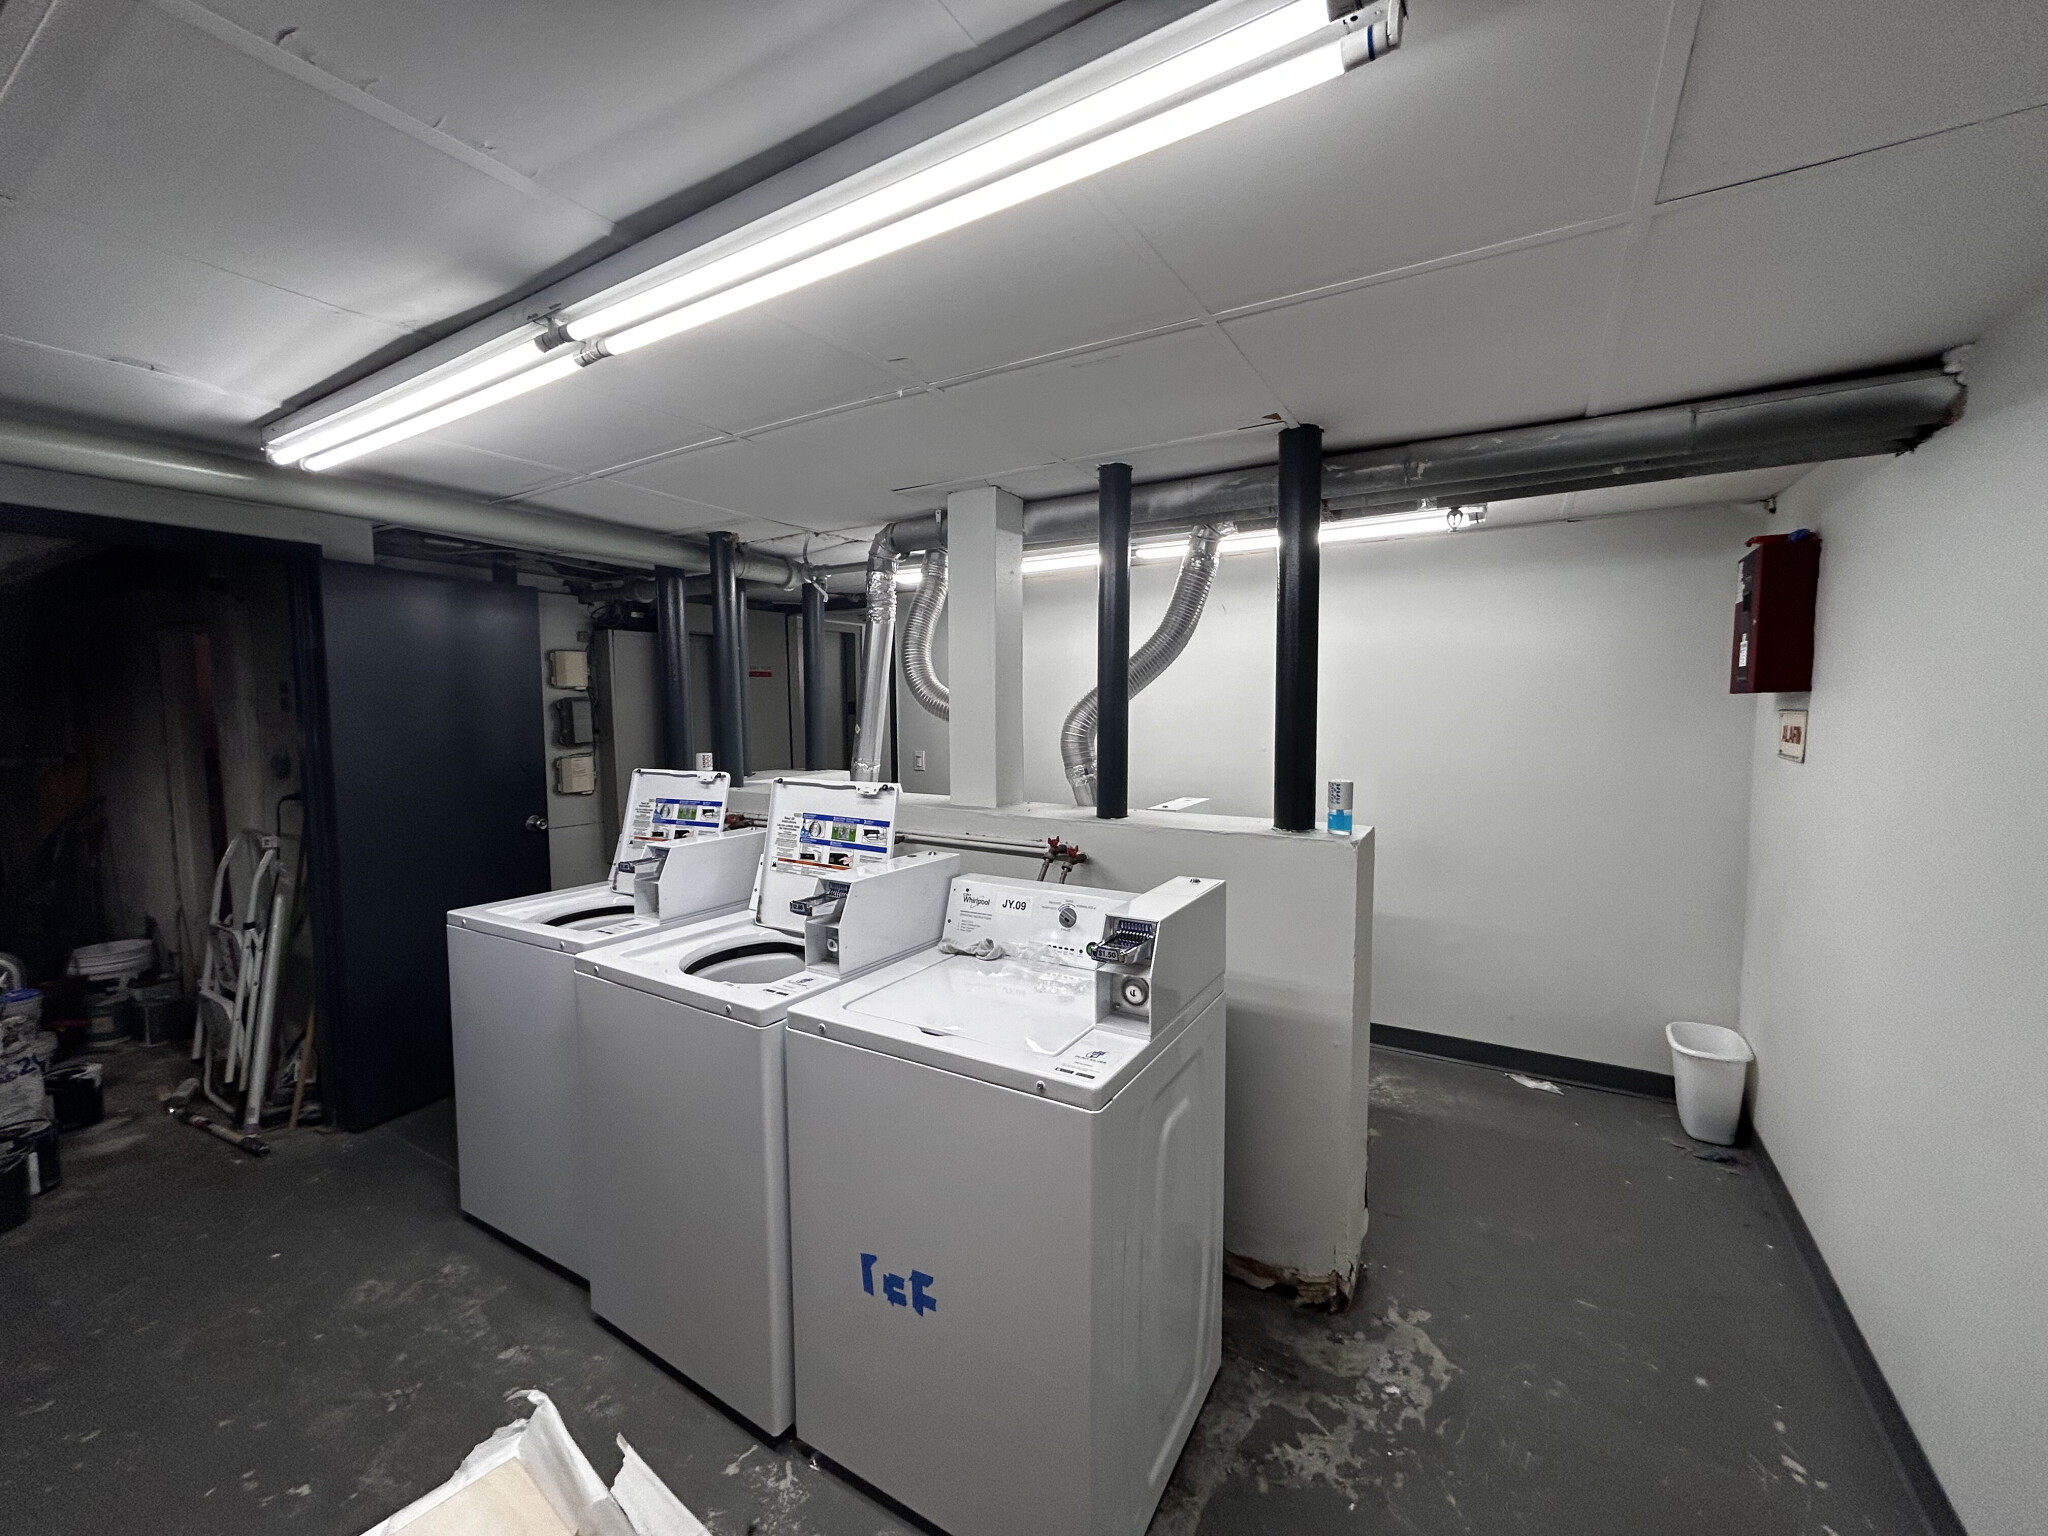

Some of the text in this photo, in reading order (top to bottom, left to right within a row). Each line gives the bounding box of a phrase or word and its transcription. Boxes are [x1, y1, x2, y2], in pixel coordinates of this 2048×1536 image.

[963, 895, 991, 906] Whirlpool
[1002, 899, 1027, 911] JY.09
[1098, 949, 1116, 959] $1.50
